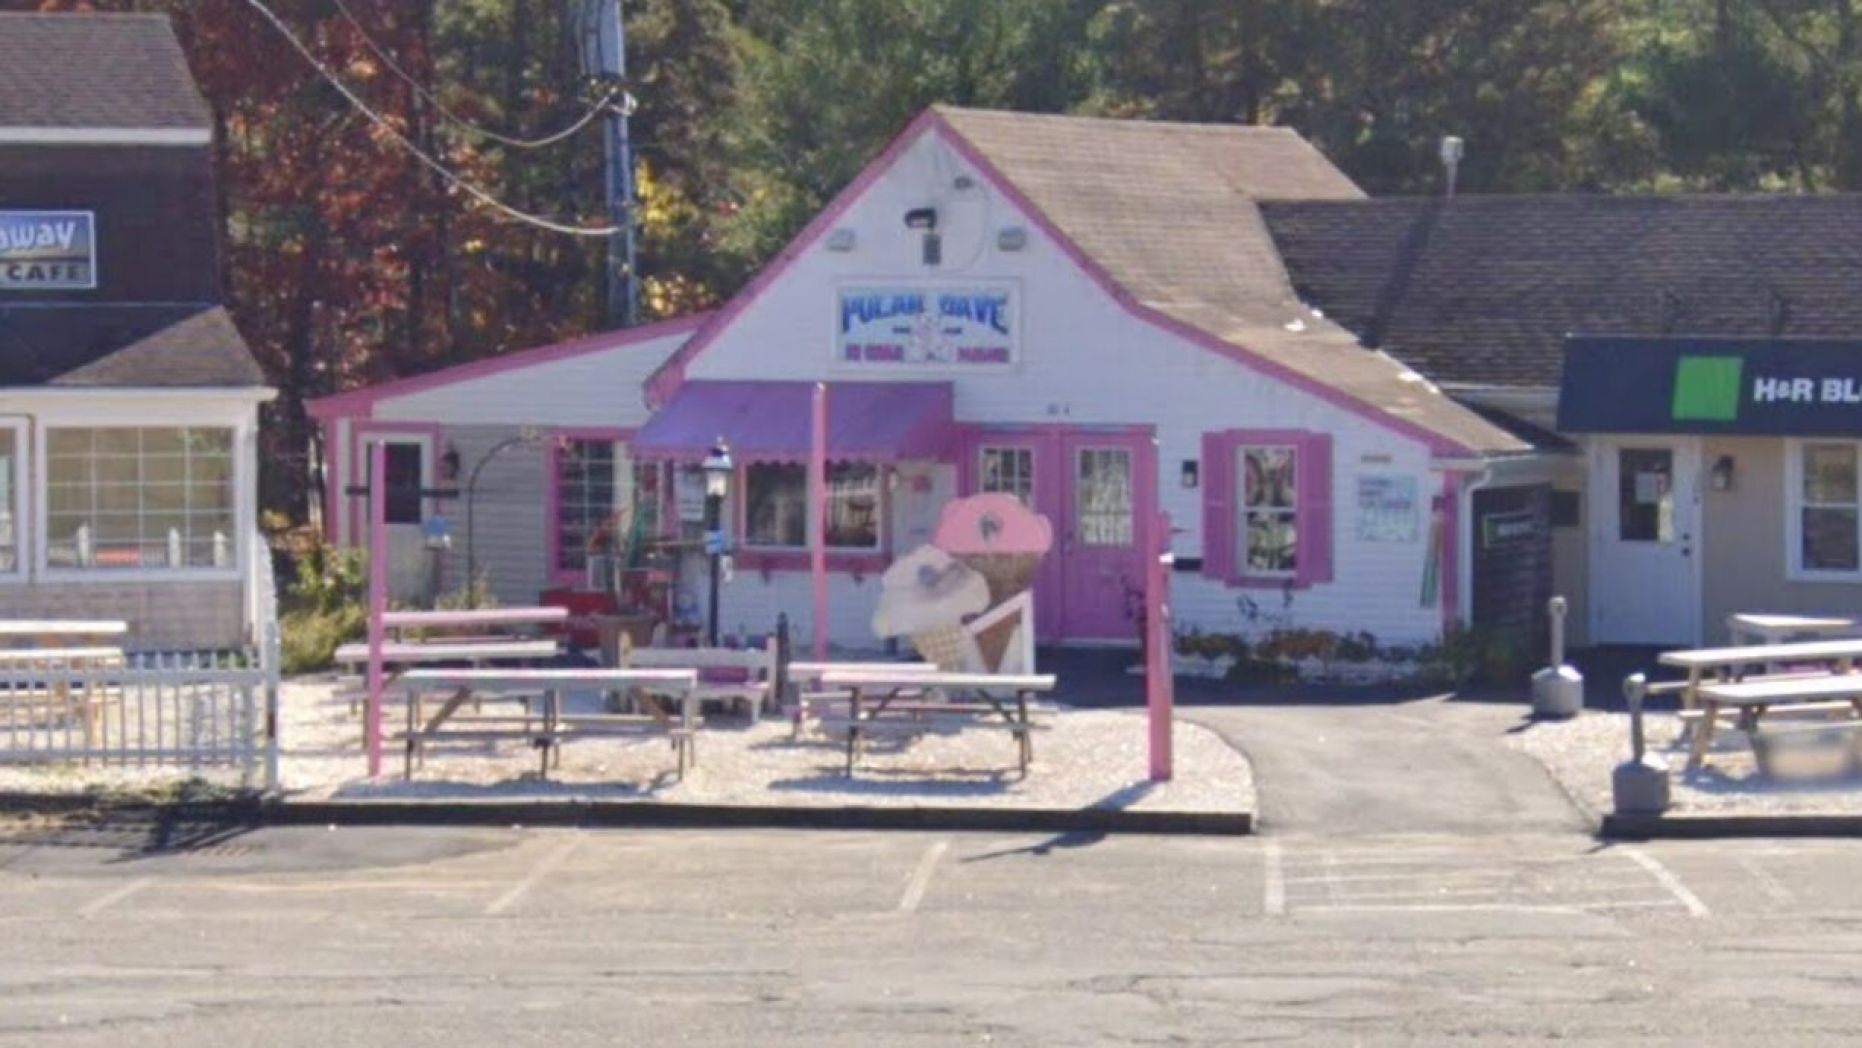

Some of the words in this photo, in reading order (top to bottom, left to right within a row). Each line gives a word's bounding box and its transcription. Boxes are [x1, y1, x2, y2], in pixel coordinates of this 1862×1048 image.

[7, 264, 82, 281] CAFE
[938, 294, 1009, 336] DAVE
[1753, 378, 1814, 401] H&R
[1820, 378, 1862, 401] BL
